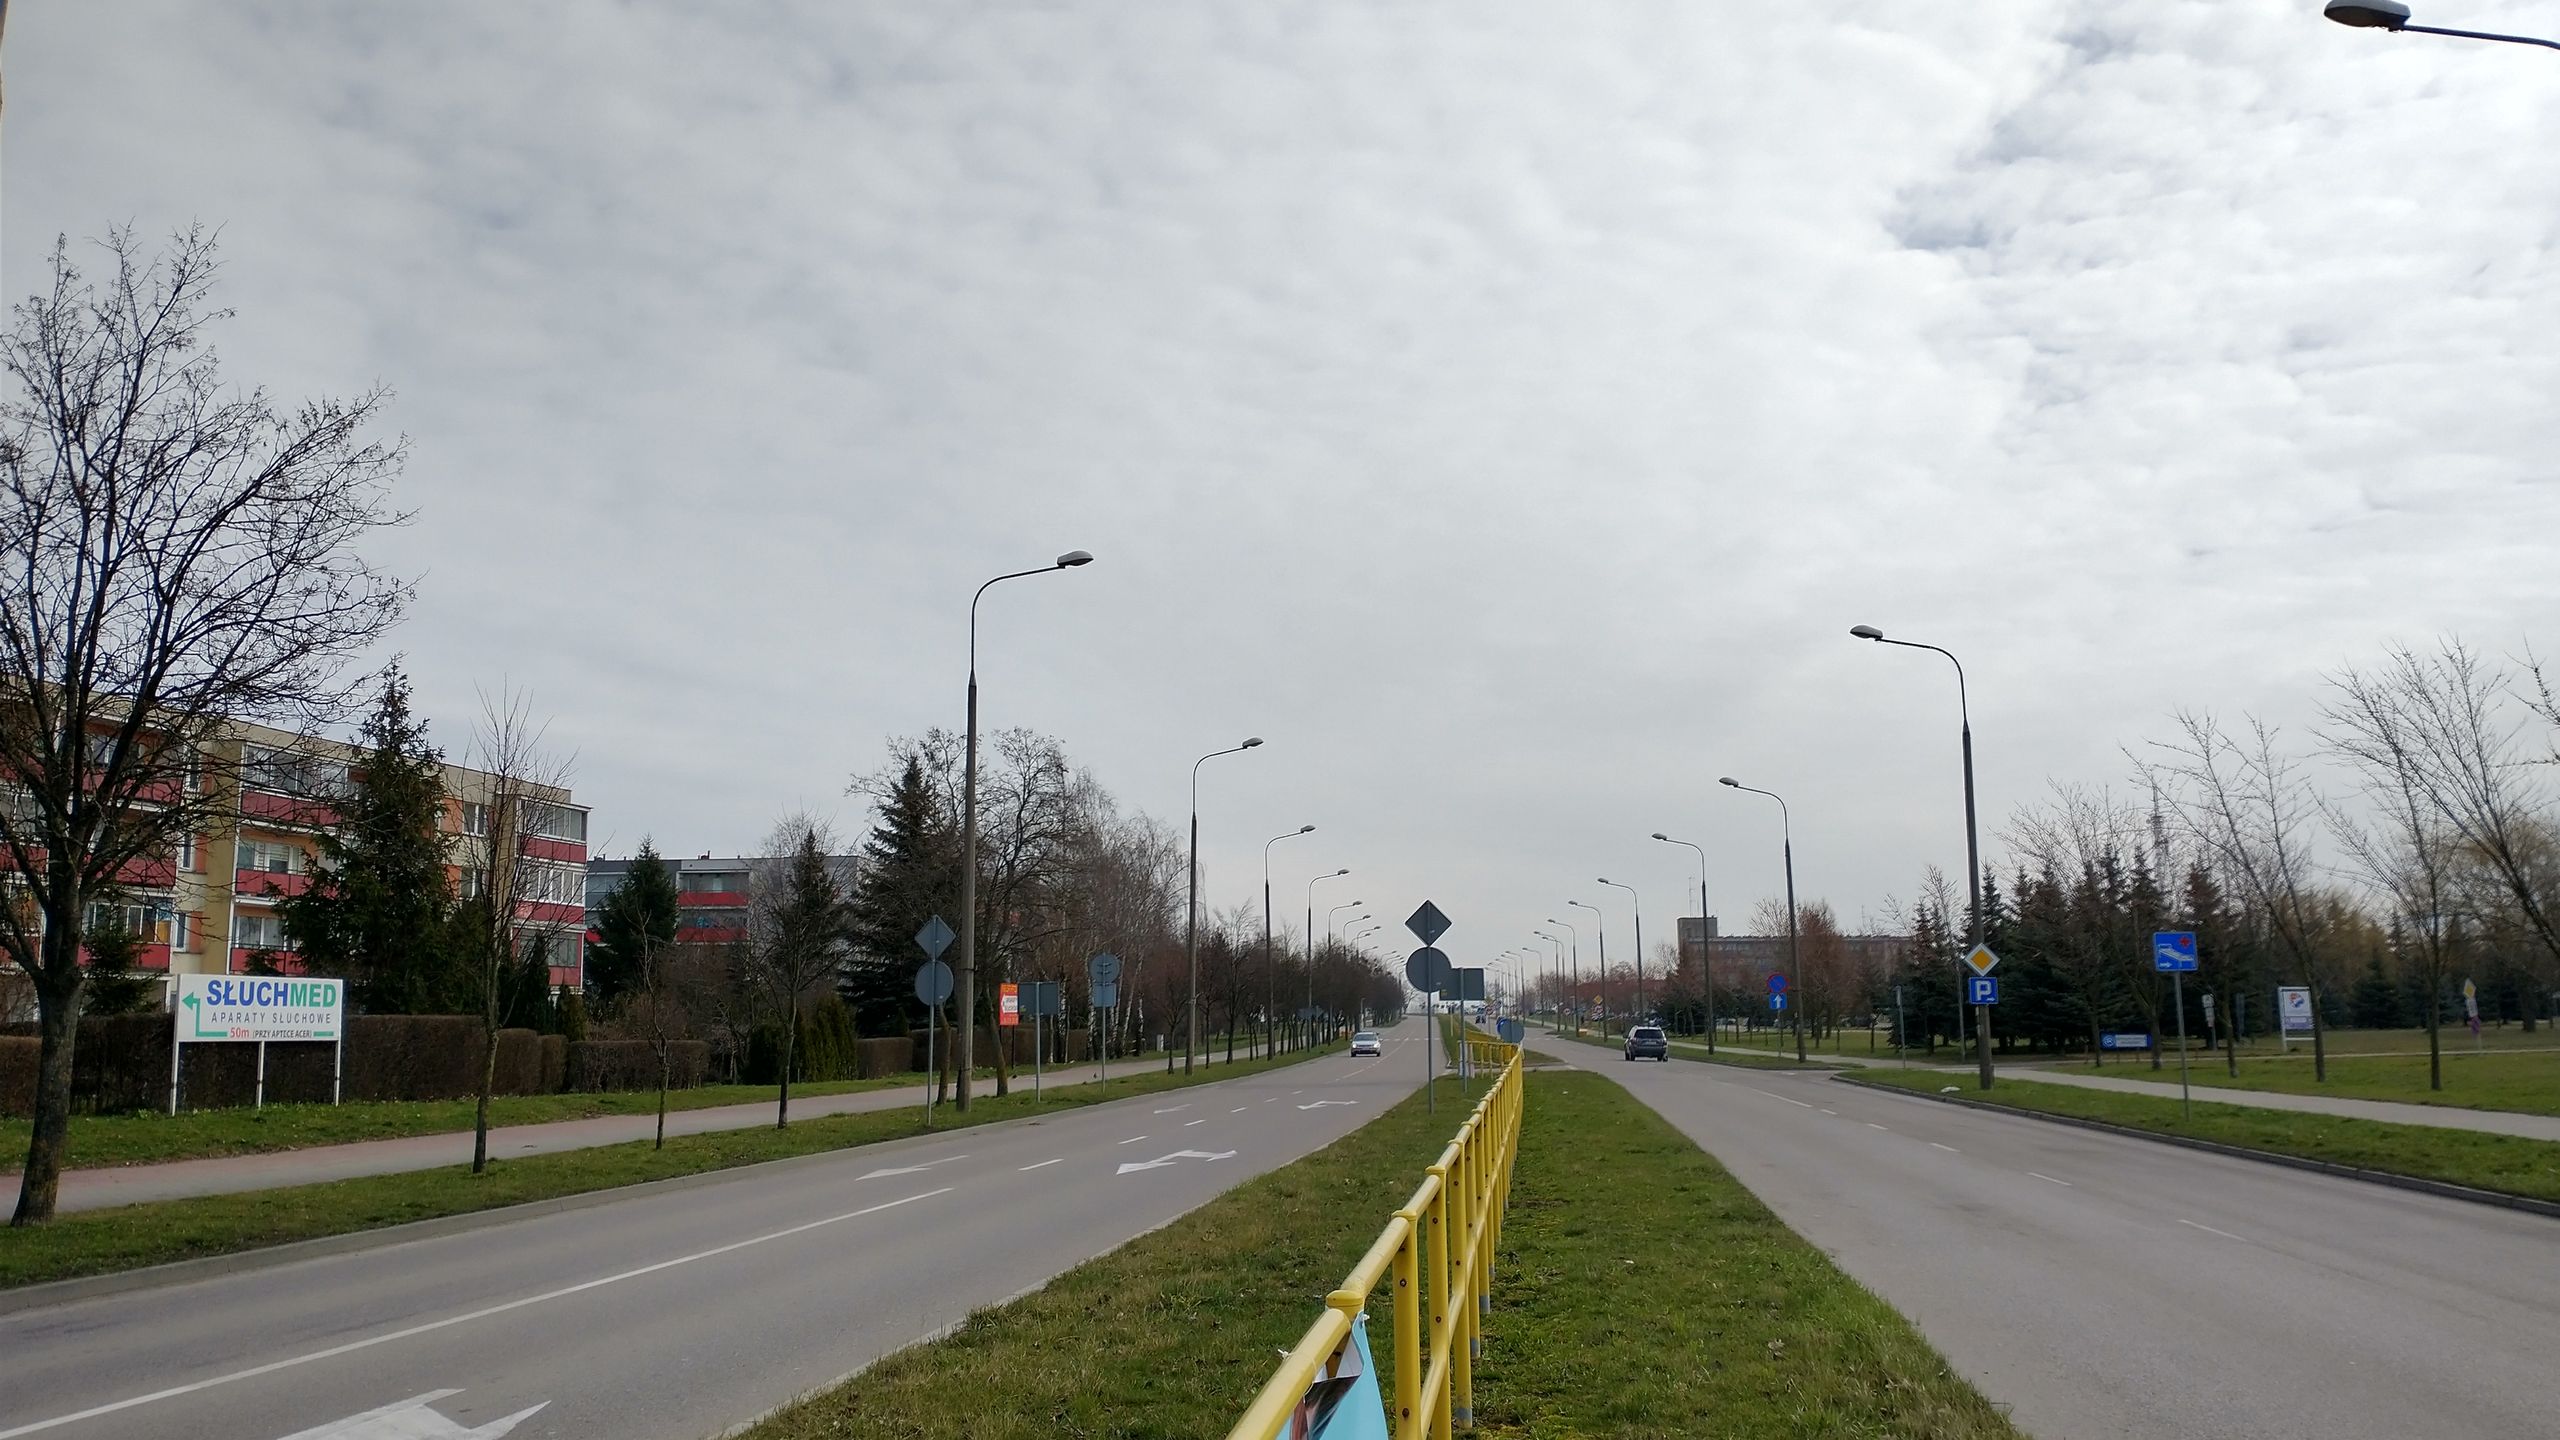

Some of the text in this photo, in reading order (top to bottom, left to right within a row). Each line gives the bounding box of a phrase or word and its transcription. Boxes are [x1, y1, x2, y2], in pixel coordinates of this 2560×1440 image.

[206, 980, 336, 1007] SŁUCHMED
[1976, 981, 1991, 1000] P
[211, 1012, 331, 1024] APARATY SŁUCHOWE
[230, 1027, 249, 1038] 50m
